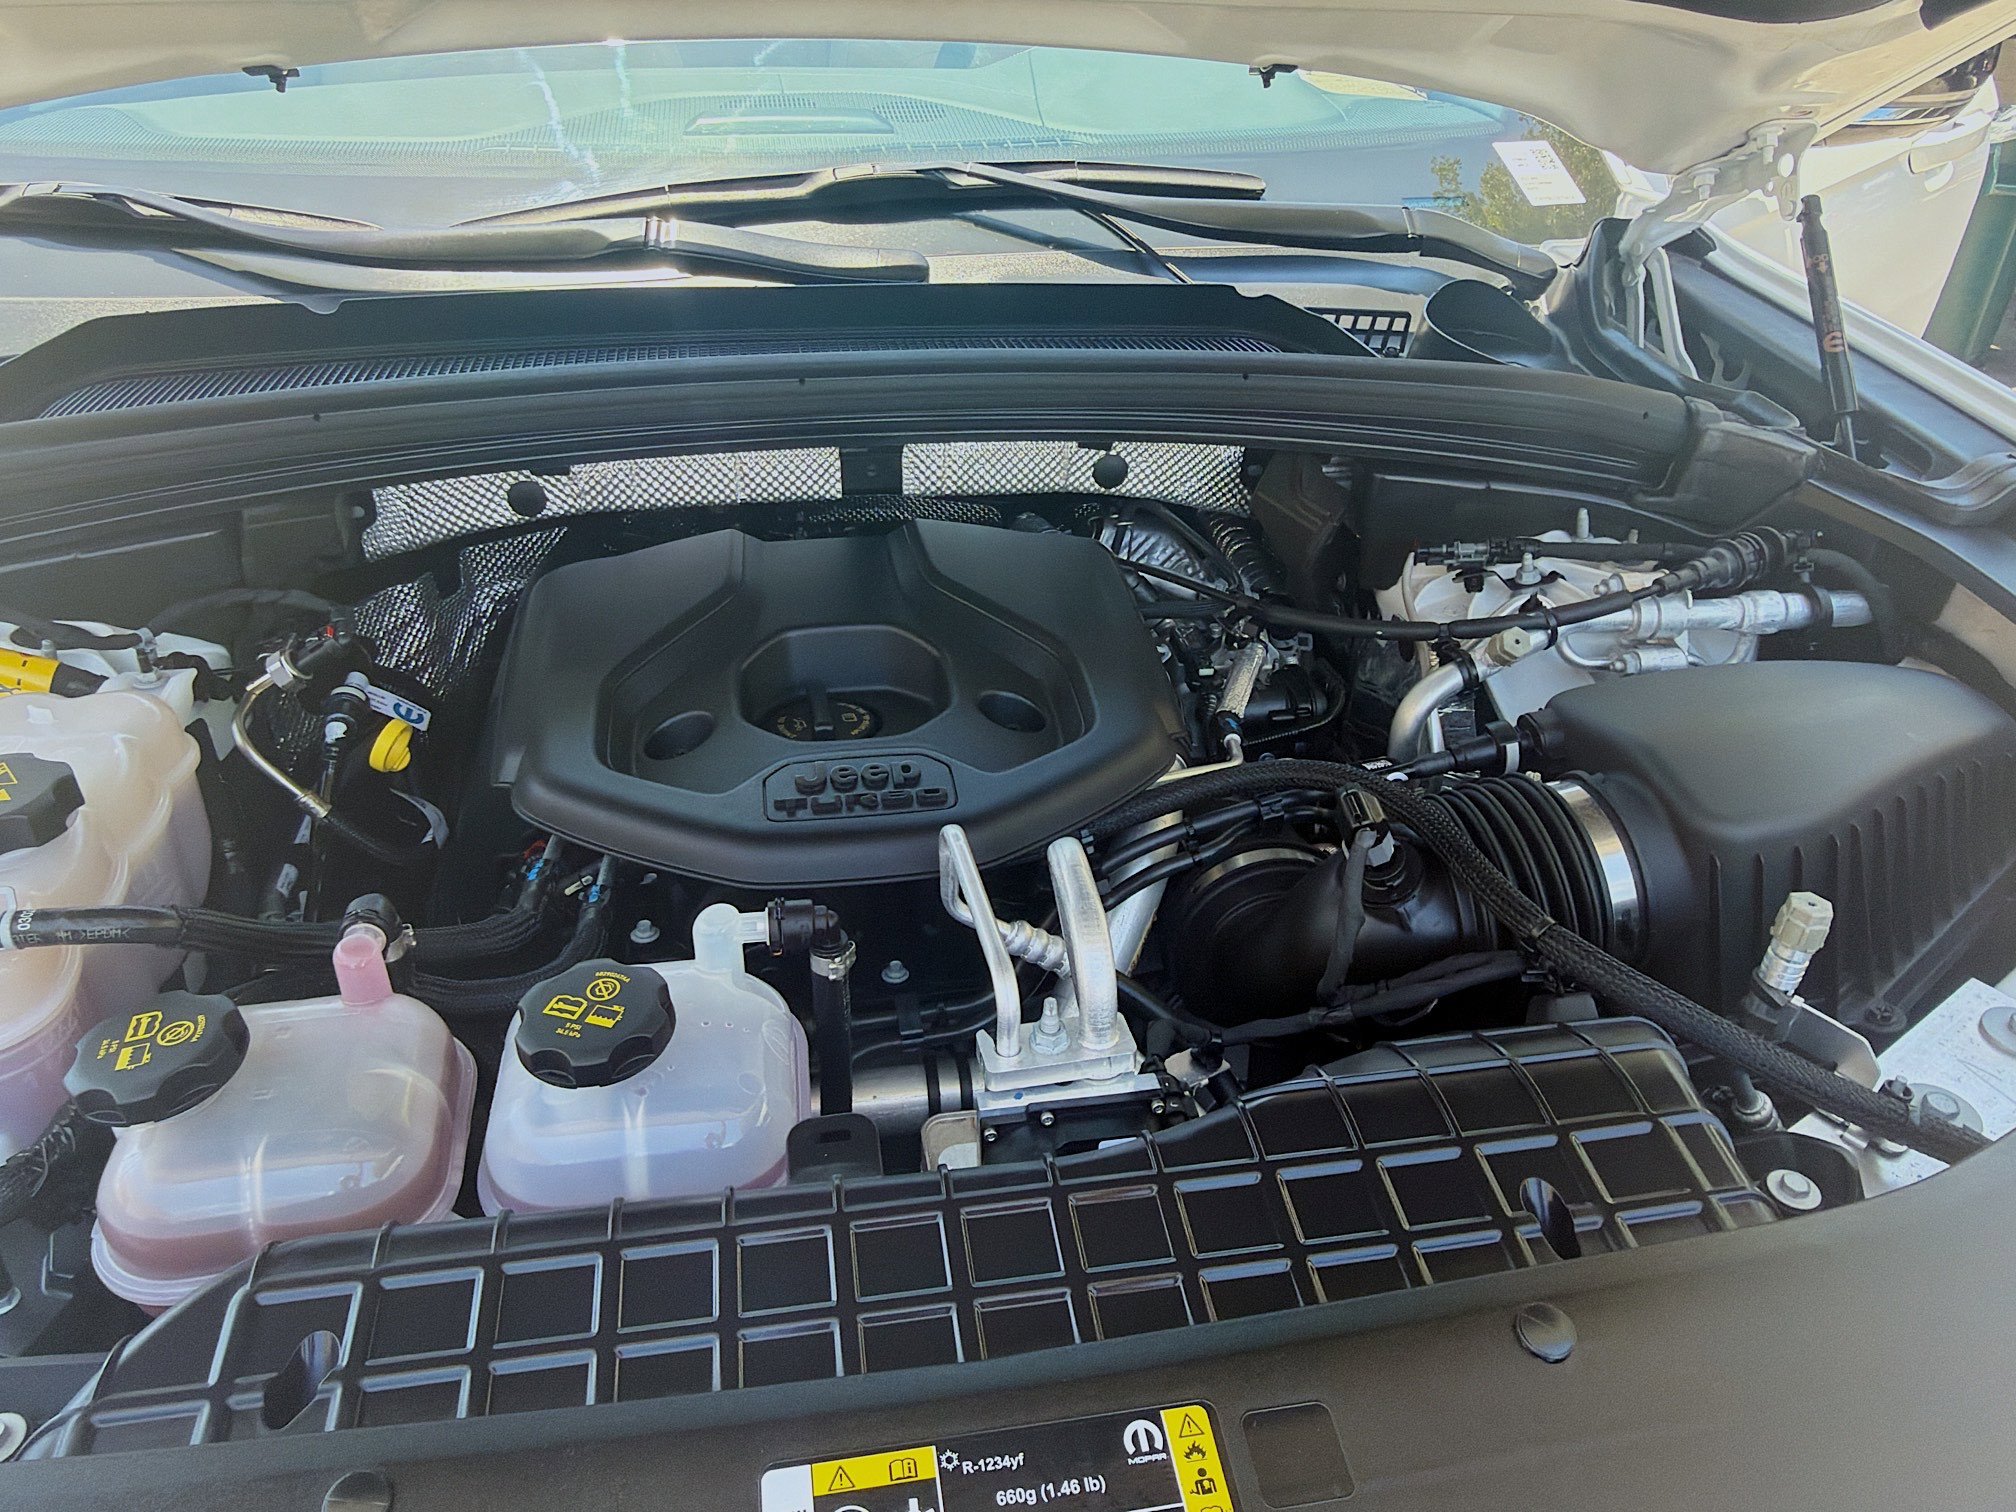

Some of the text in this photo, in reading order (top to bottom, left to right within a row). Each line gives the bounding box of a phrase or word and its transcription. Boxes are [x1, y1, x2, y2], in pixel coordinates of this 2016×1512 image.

[794, 760, 922, 795] Jeep
[773, 787, 949, 818] TURBO
[962, 1452, 1025, 1475] R-1234yf
[1128, 1452, 1167, 1465] MOPAR
[996, 1474, 1107, 1506] 660g (1.46 lb)
